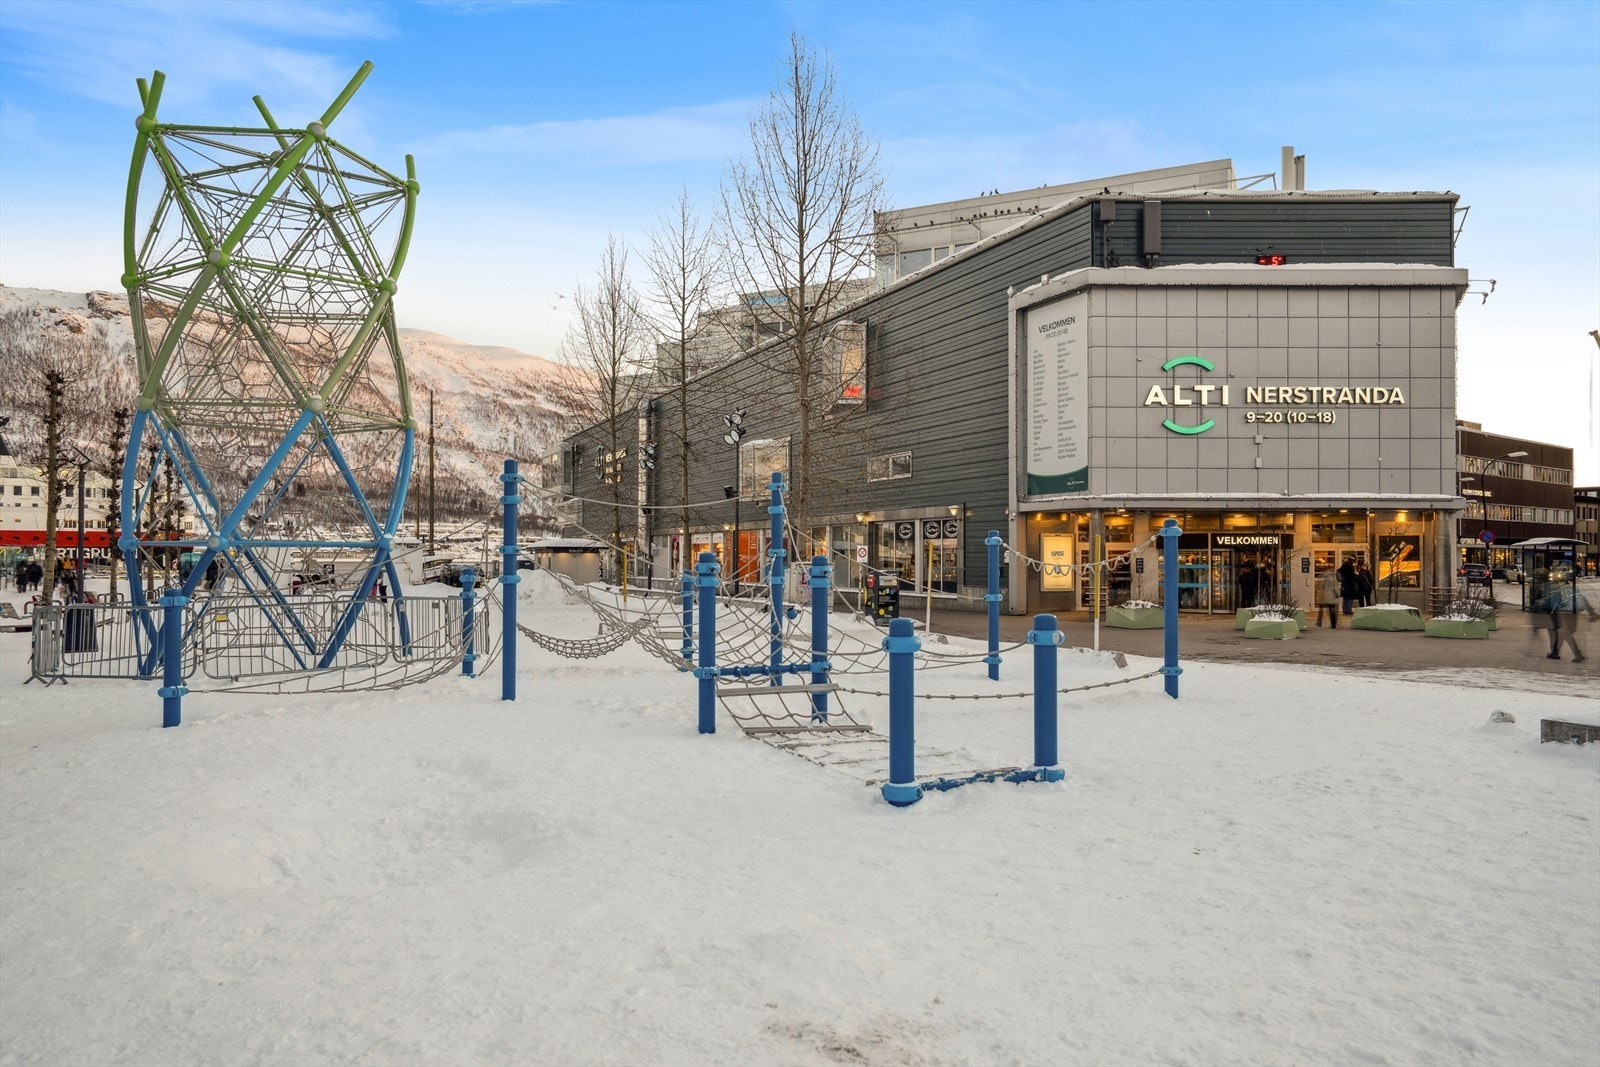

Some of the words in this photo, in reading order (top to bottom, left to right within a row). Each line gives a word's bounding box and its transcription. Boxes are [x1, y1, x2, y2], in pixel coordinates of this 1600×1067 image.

[1038, 316, 1076, 333] VELKOMMEN
[1144, 384, 1229, 406] ALTI
[1246, 386, 1406, 404] NERSTRANDA
[1216, 536, 1279, 545] VELKOMMEN
